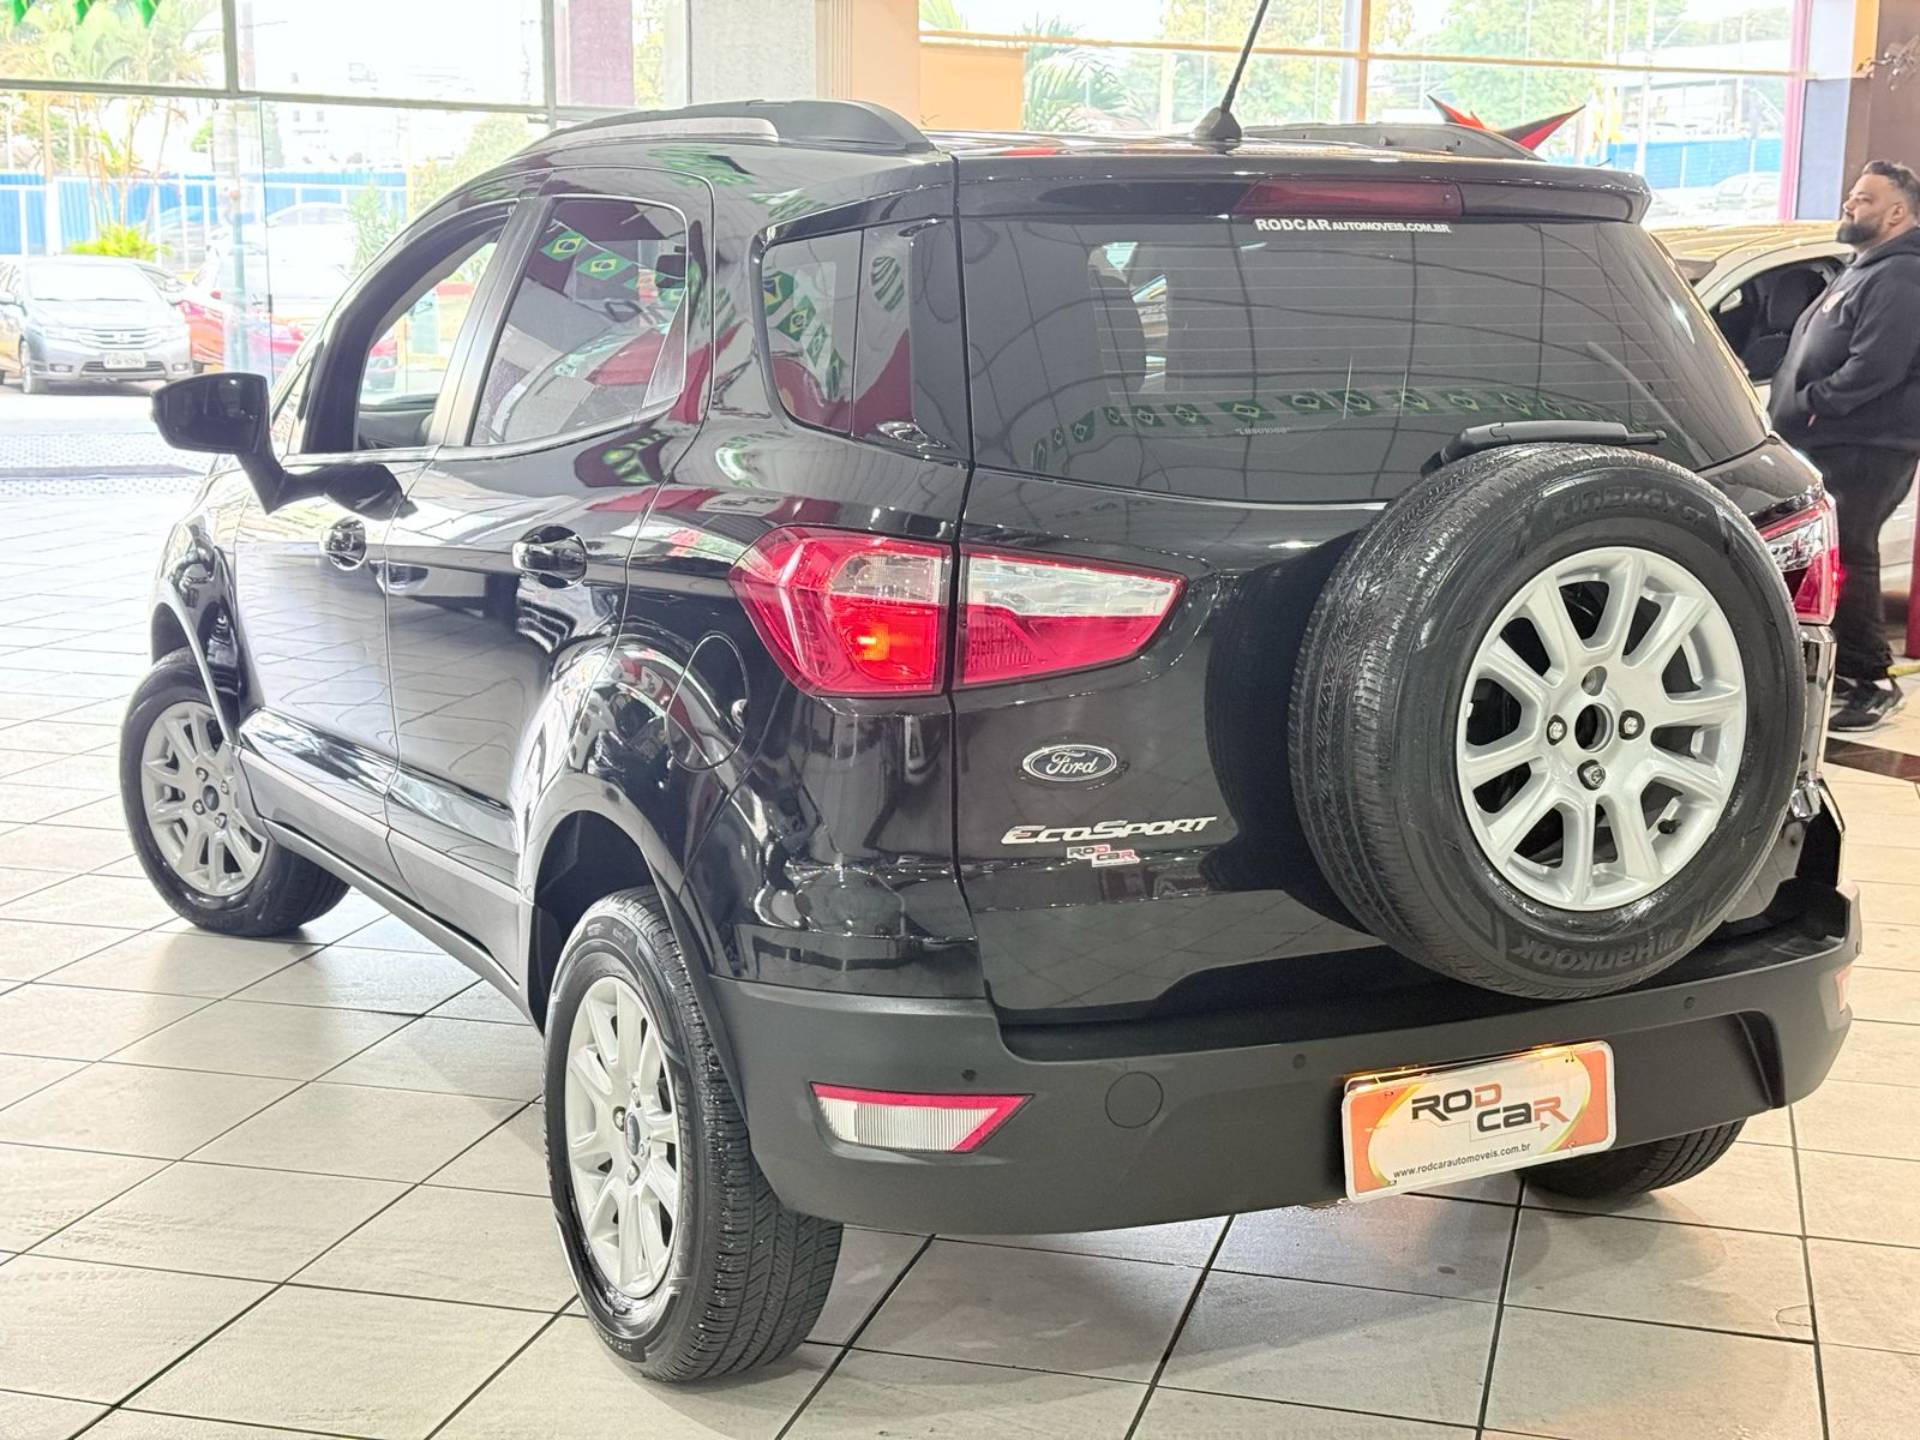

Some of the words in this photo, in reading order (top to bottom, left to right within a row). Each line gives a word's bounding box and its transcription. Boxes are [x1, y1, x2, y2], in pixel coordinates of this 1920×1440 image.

[1046, 750, 1099, 775] Ford
[1411, 1083, 1502, 1121] ROD
[1393, 1141, 1532, 1179] www.rodcarautomoveis.com.br
